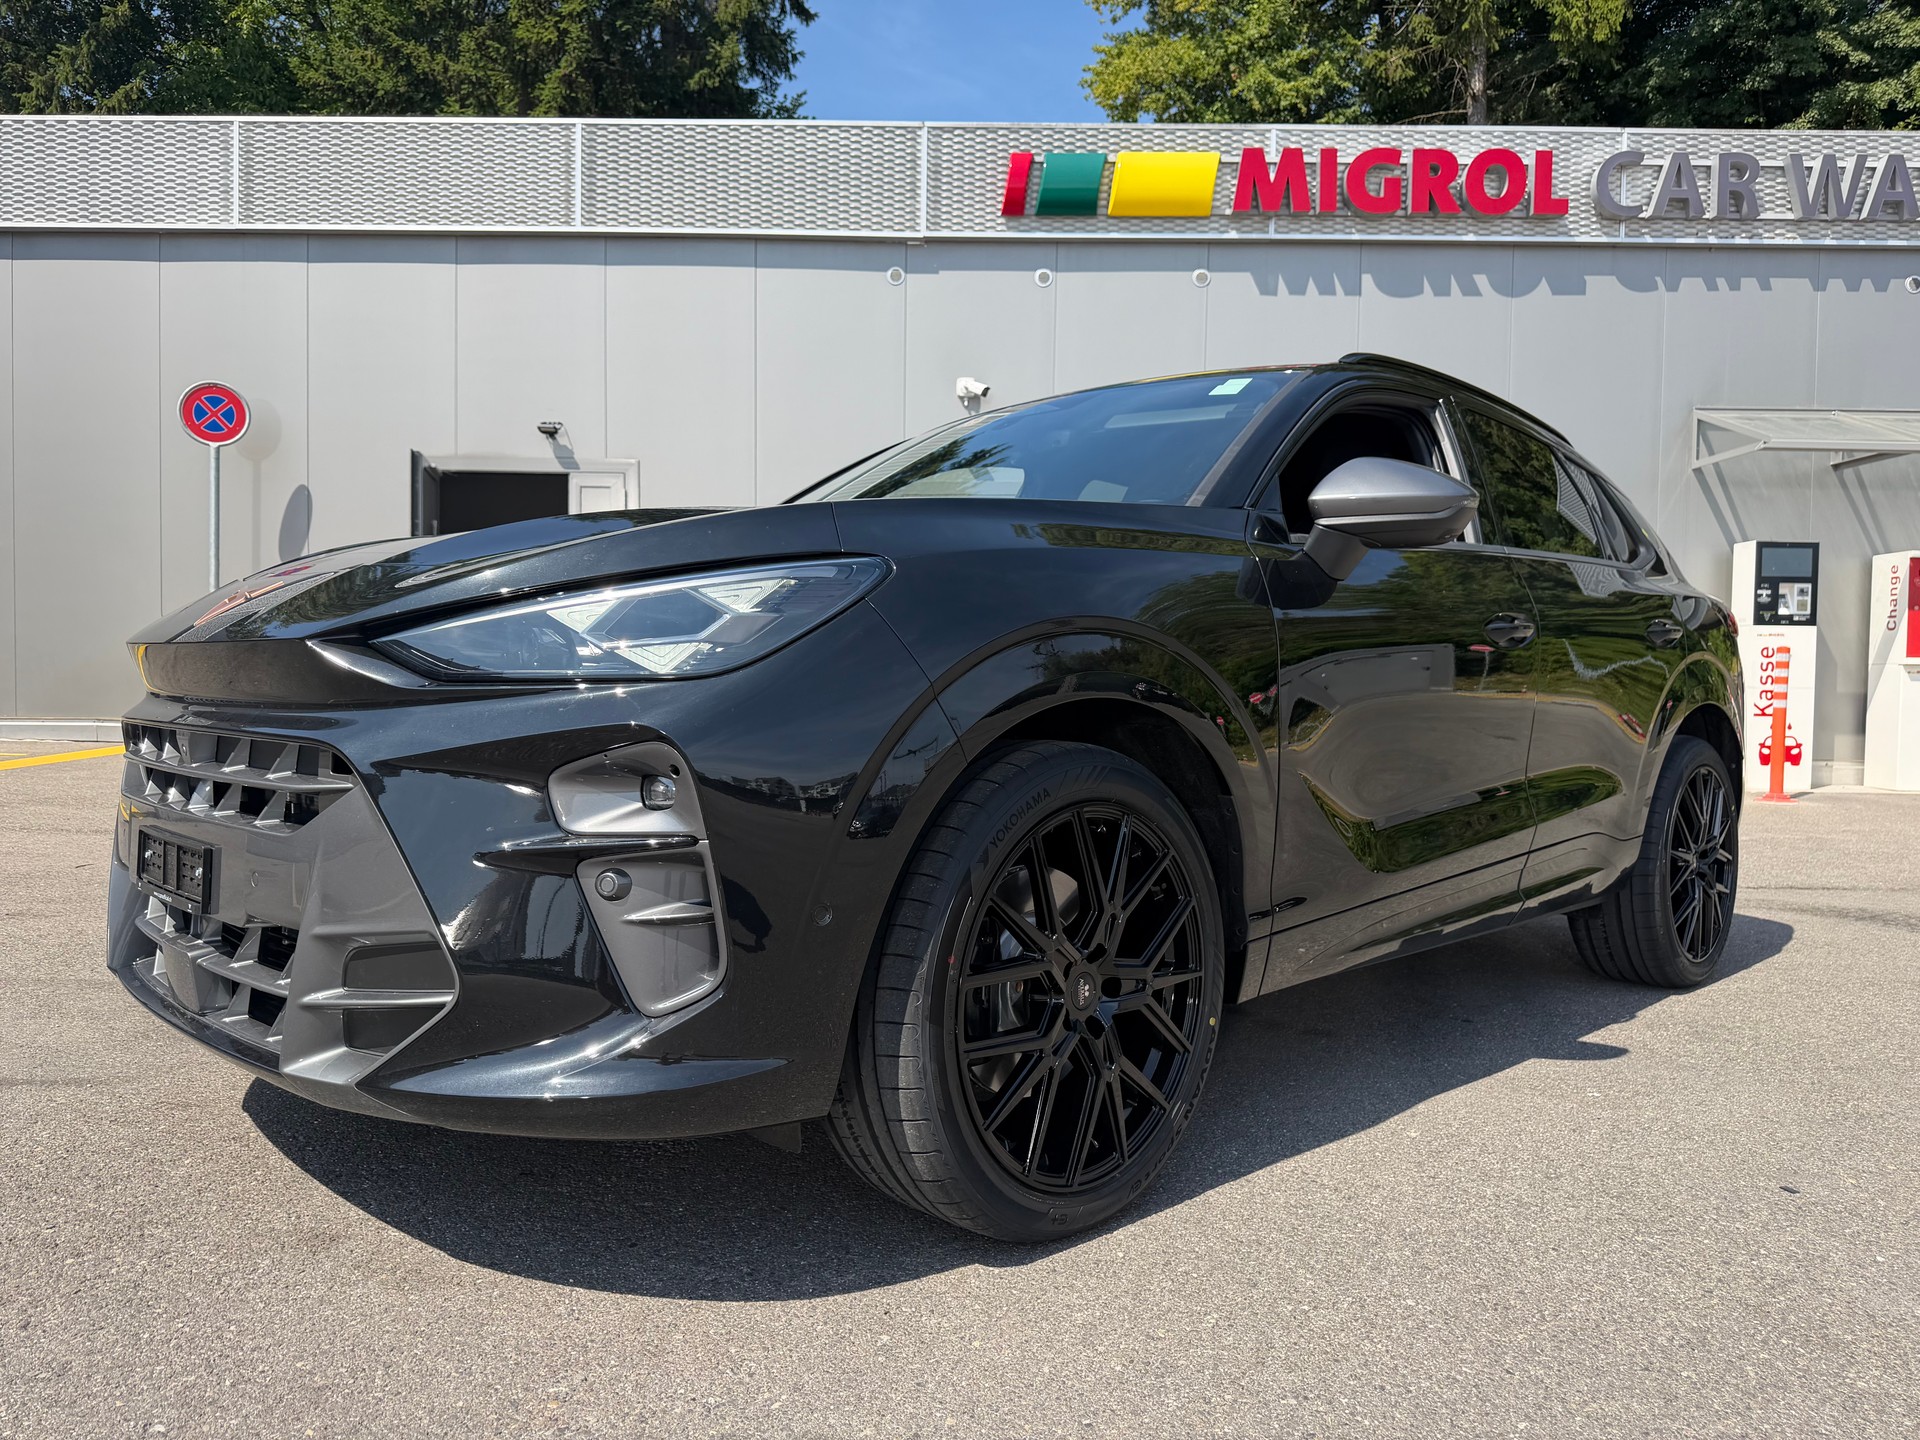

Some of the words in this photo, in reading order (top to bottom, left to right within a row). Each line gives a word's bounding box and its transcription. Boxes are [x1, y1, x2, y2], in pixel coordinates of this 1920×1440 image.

[1232, 147, 1569, 216] MIGROL
[1592, 150, 1761, 220] CAR
[1886, 564, 1900, 631] Change
[1753, 646, 1775, 717] Kasse
[989, 787, 1051, 848] YOKOHAMA
[1184, 1027, 1216, 1121] ADVAN
